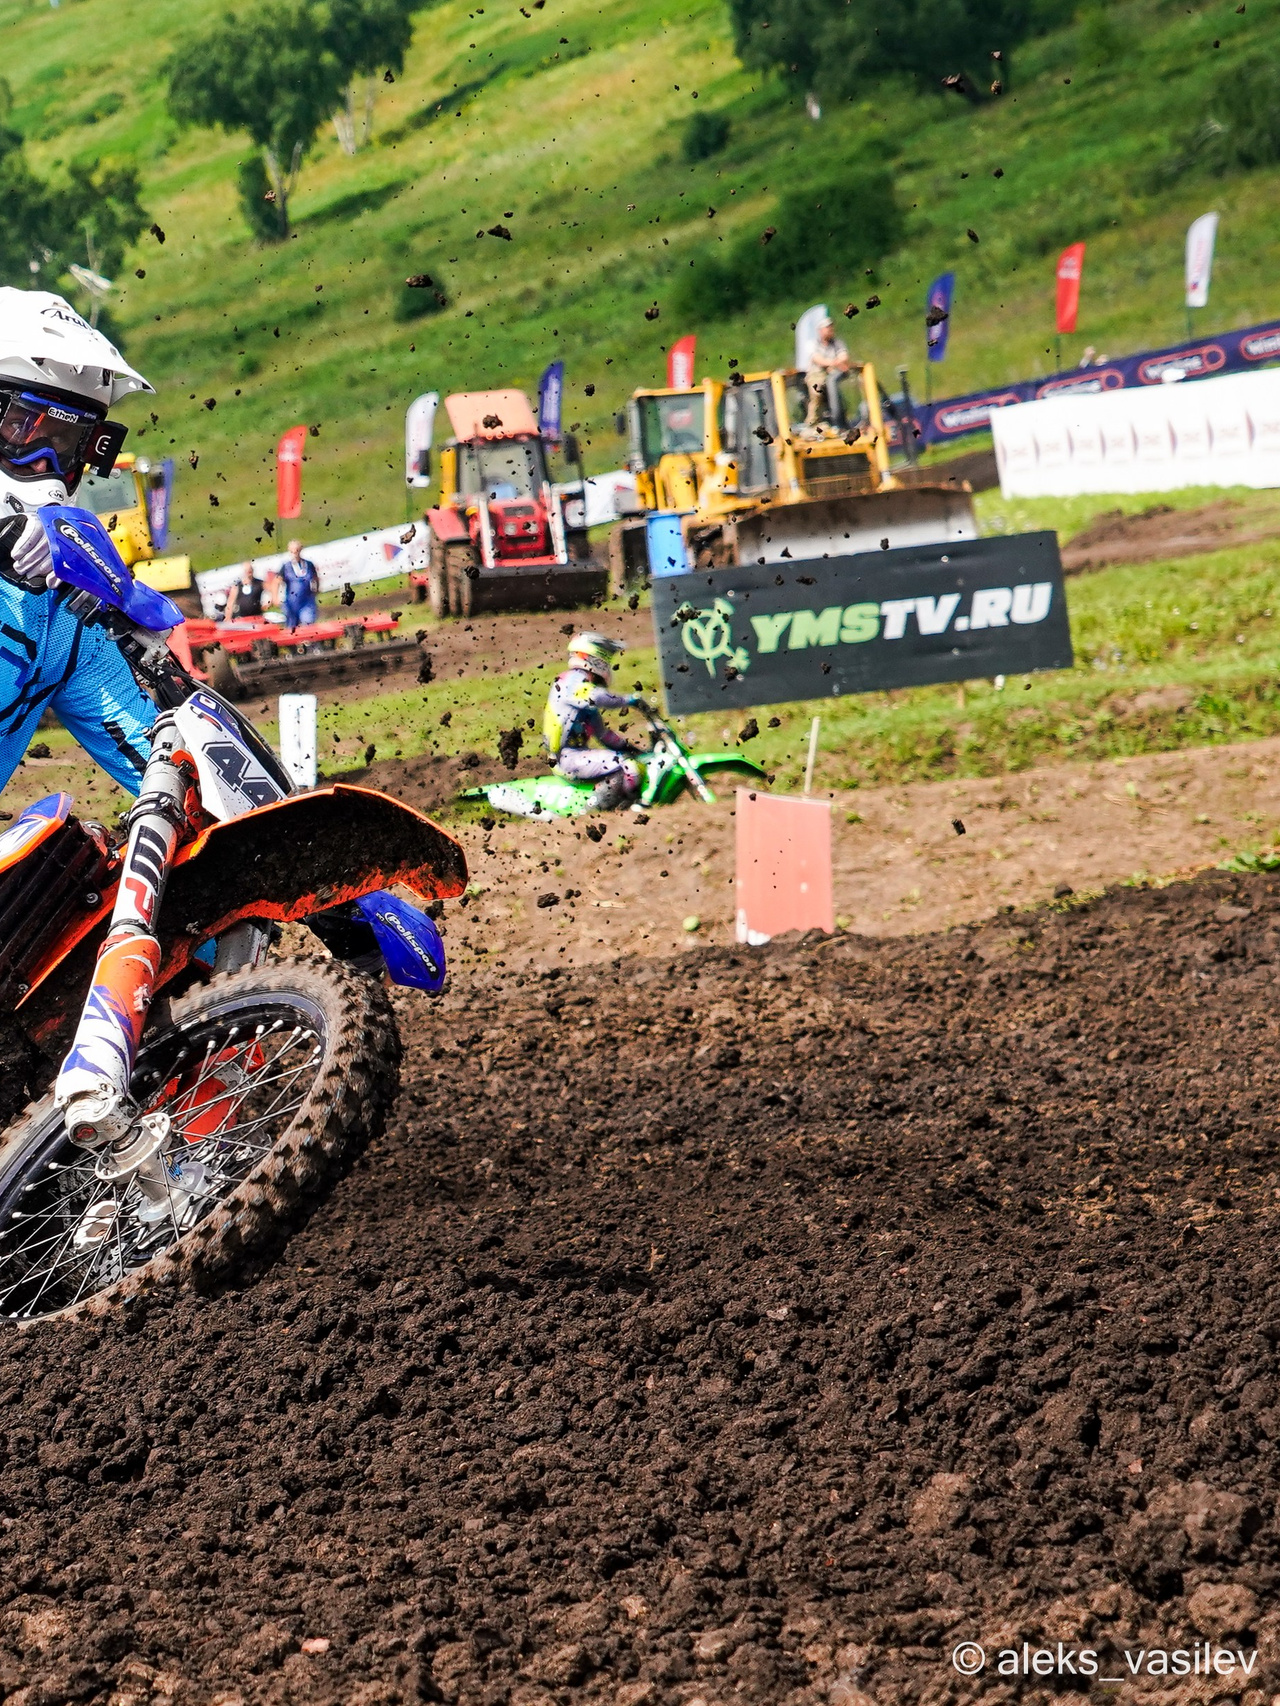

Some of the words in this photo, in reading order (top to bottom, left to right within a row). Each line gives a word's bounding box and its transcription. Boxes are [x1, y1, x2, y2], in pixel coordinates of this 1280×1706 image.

[60, 524, 121, 584] Polisport
[750, 582, 1053, 654] YMSTV.RU
[384, 911, 437, 973] Polisport
